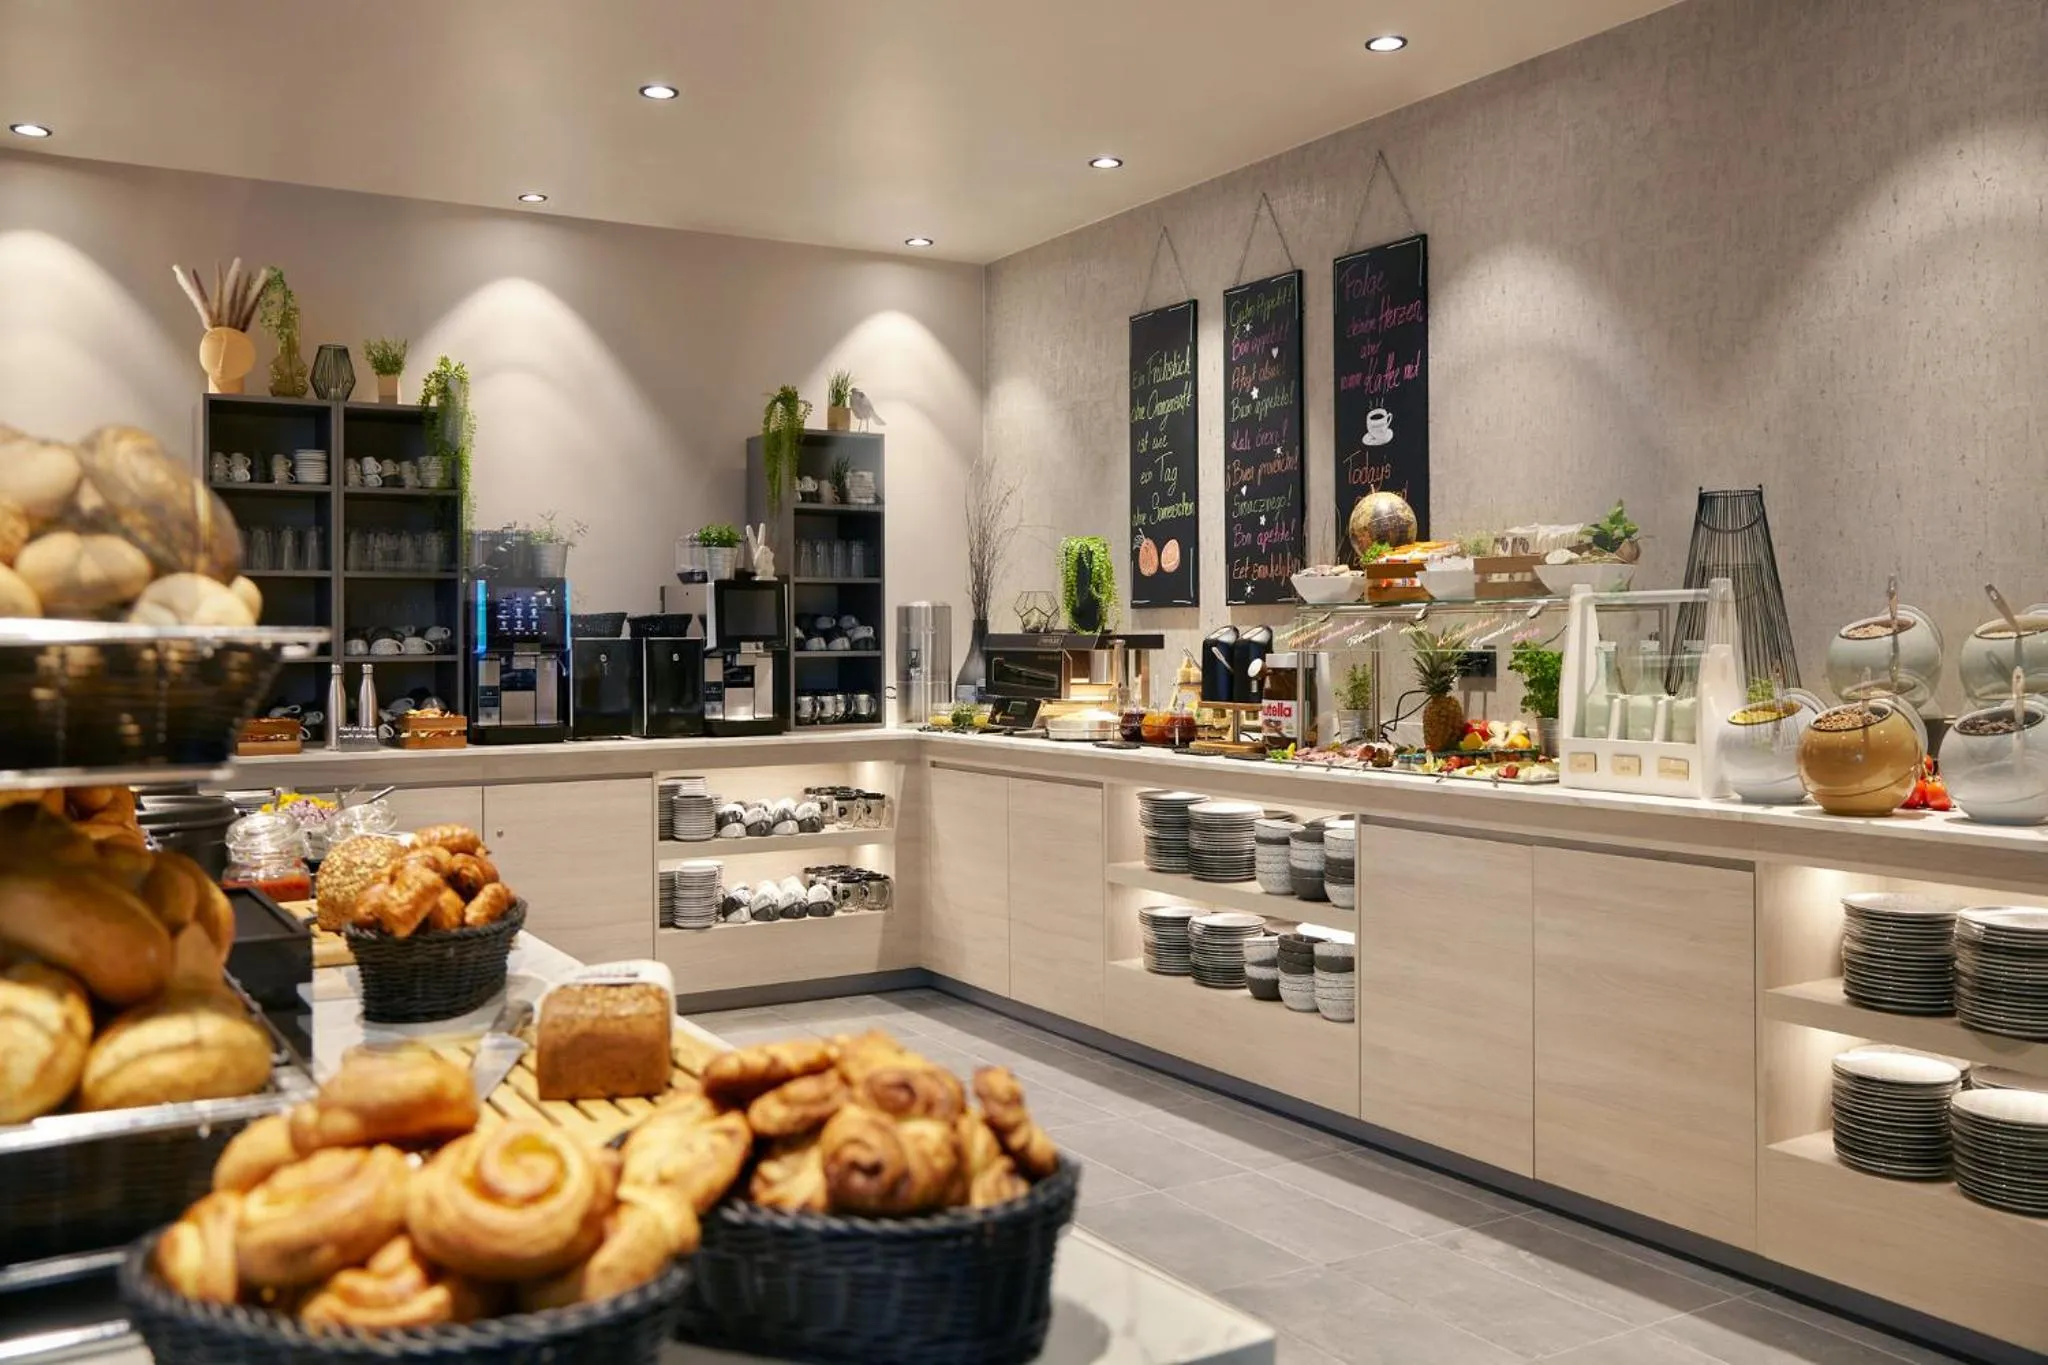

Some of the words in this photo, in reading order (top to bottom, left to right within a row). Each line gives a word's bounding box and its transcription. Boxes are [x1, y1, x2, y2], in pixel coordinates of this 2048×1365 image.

[1378, 294, 1424, 335] Herzen
[1155, 451, 1178, 497] Tag
[1262, 702, 1292, 717] utella
